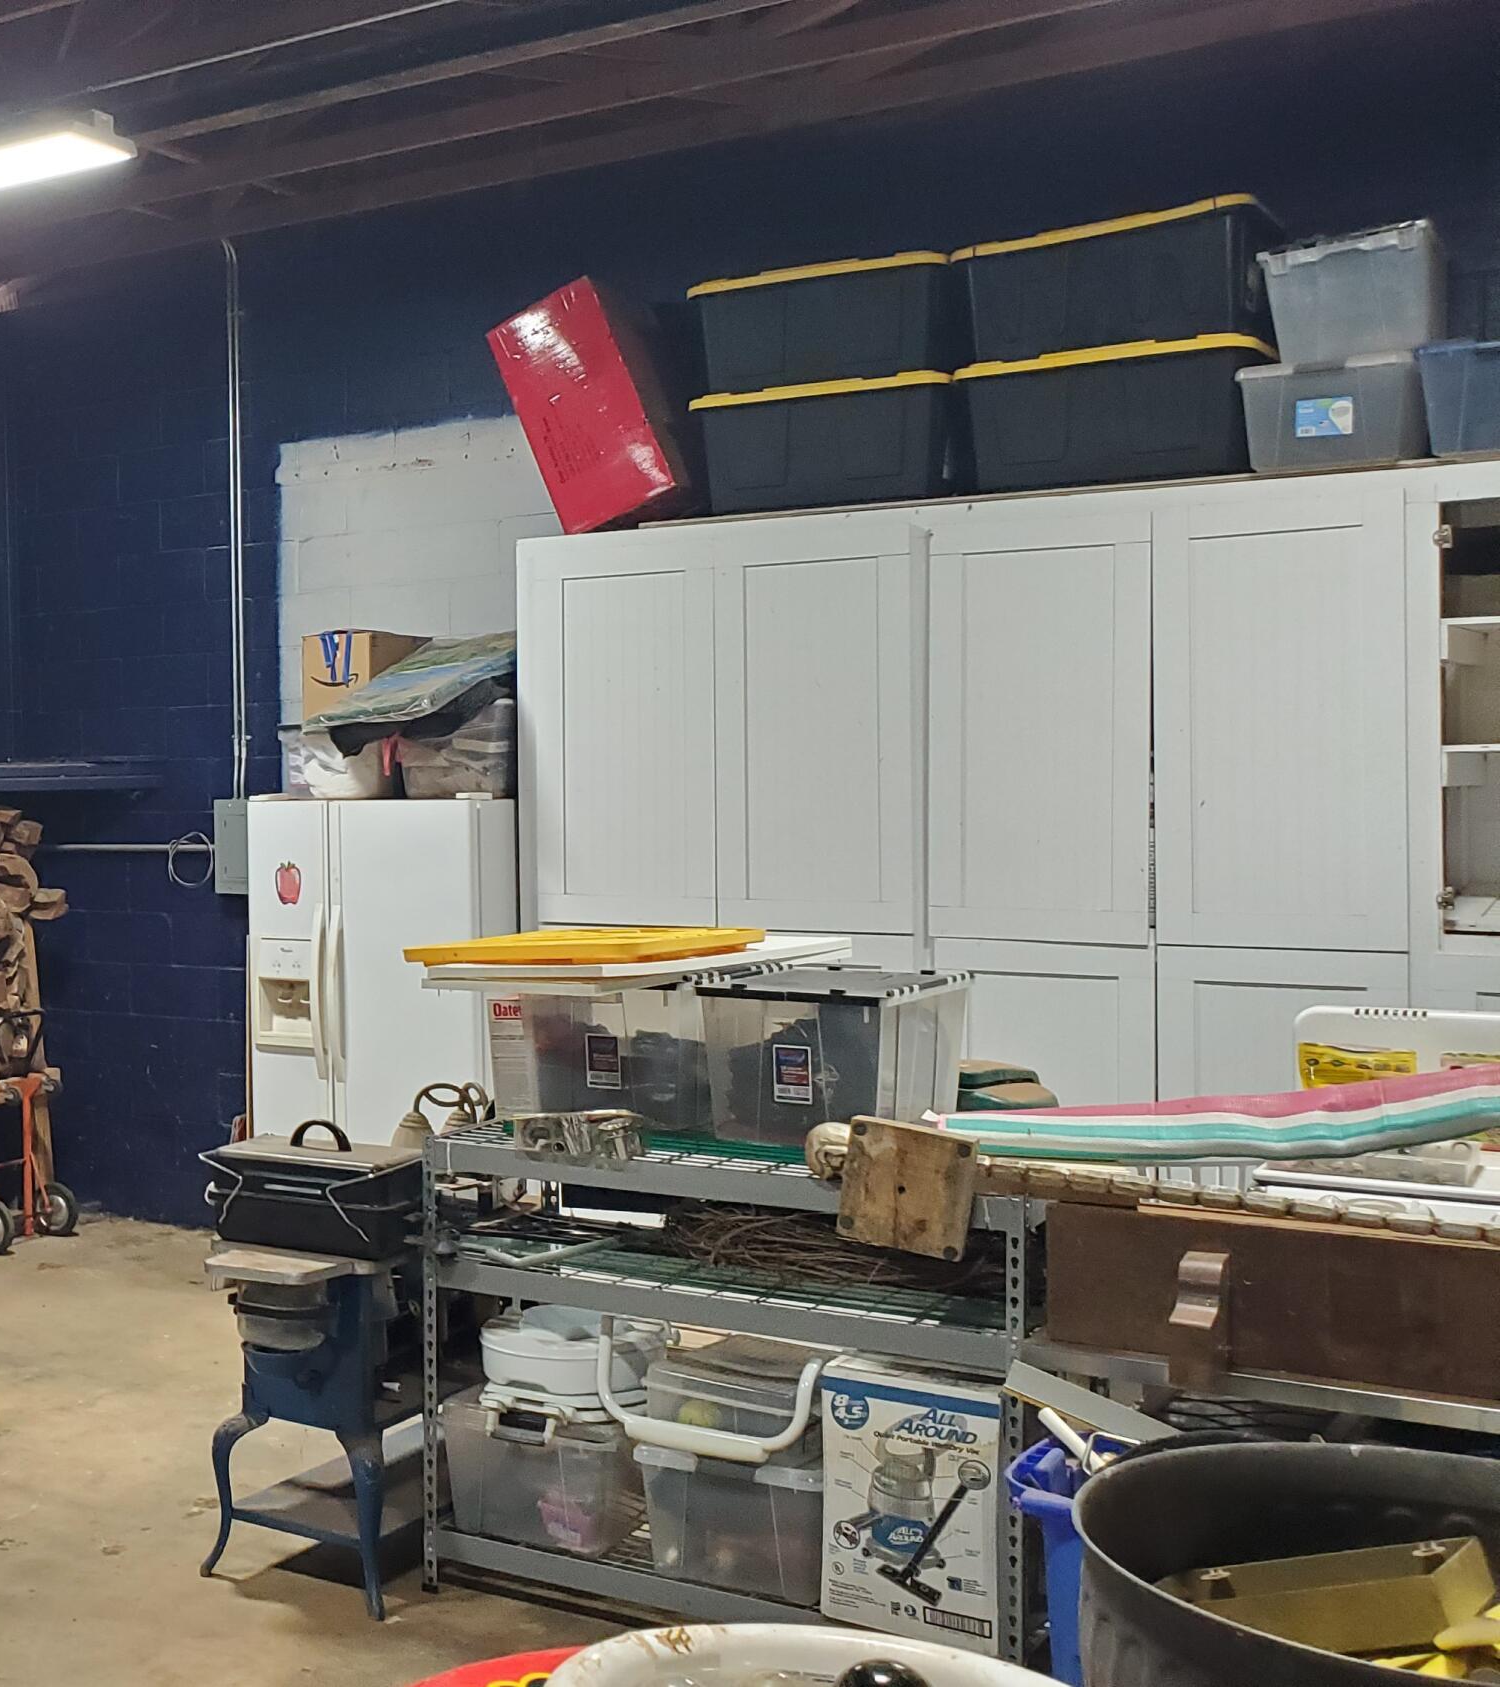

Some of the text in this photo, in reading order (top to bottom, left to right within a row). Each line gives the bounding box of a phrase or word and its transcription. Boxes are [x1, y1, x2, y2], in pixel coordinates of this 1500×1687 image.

[919, 1406, 957, 1427] ALL
[895, 1418, 978, 1444] AROUND
[897, 1434, 930, 1447] Portable
